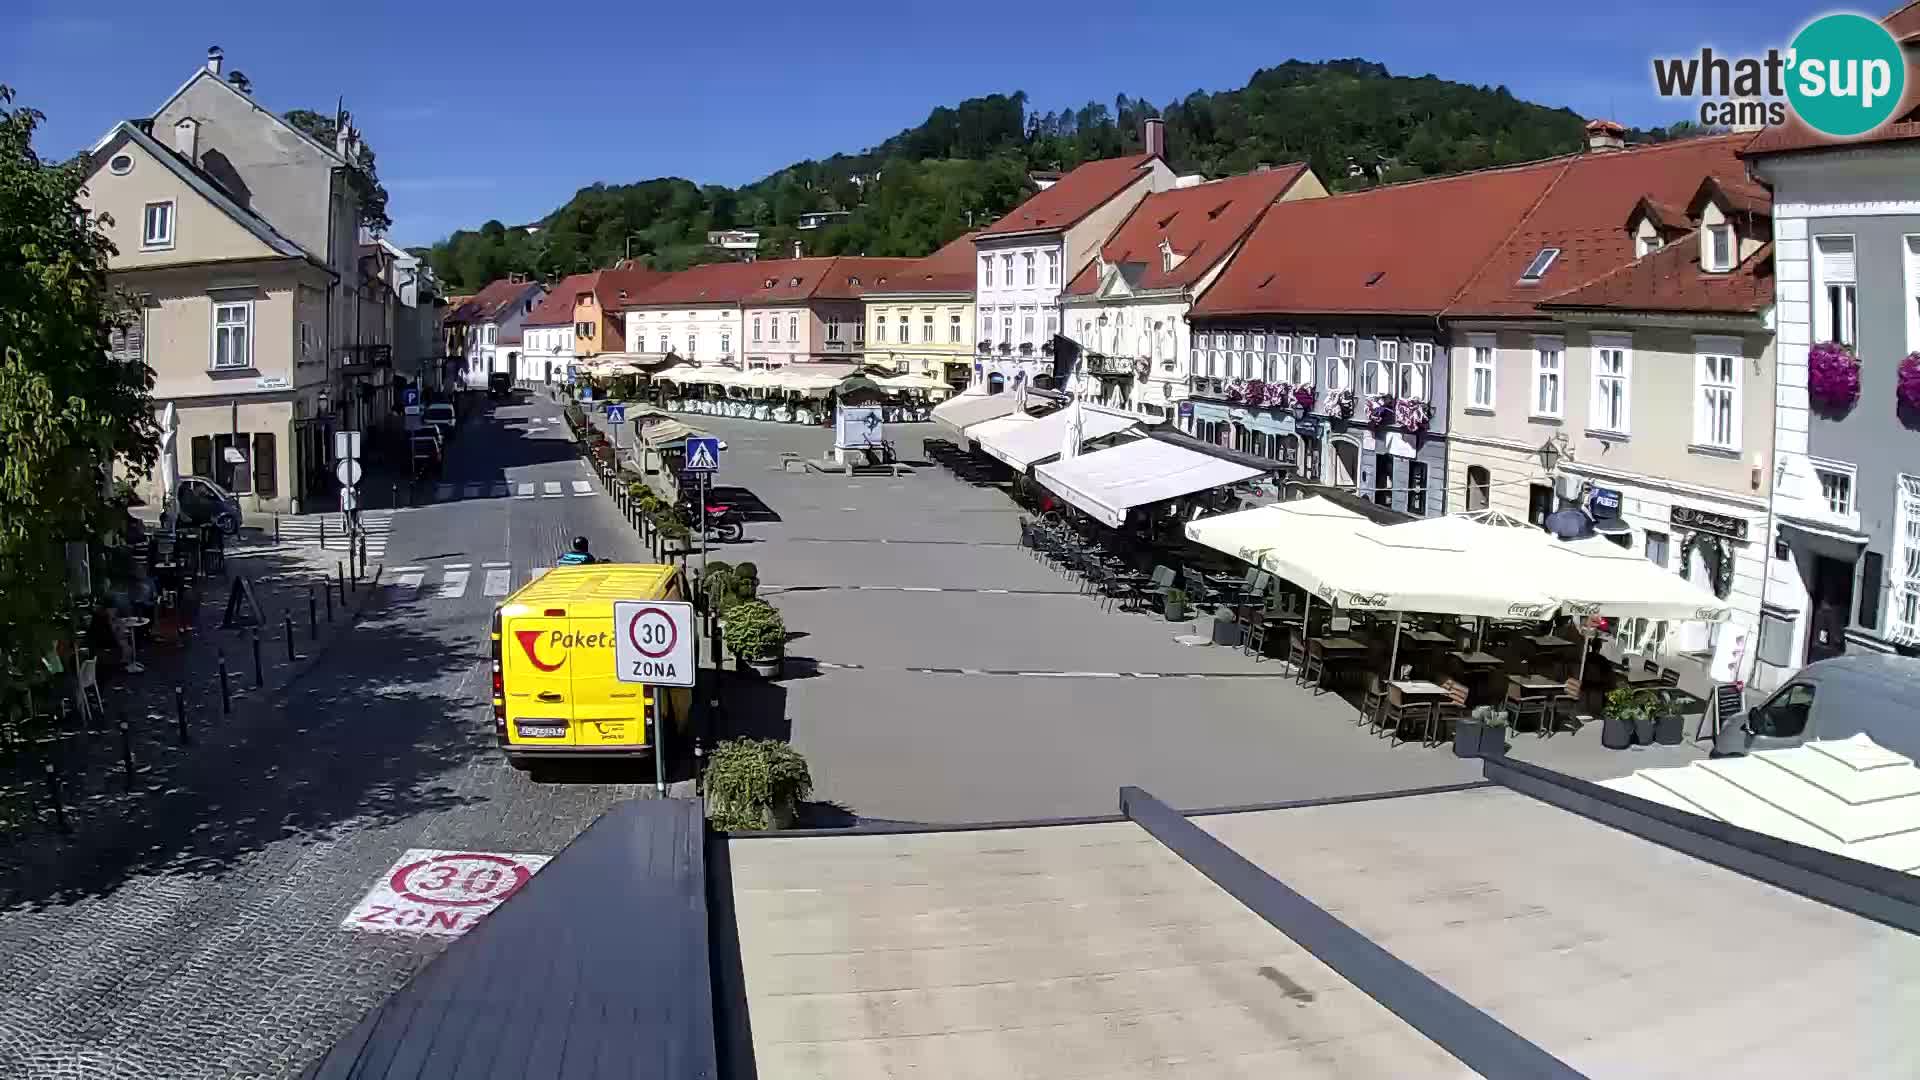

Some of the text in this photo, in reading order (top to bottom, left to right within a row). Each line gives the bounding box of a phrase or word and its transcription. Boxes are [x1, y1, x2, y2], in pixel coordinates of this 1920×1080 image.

[641, 623, 666, 645] 30
[632, 661, 677, 678] ZONA
[418, 866, 504, 894] 30
